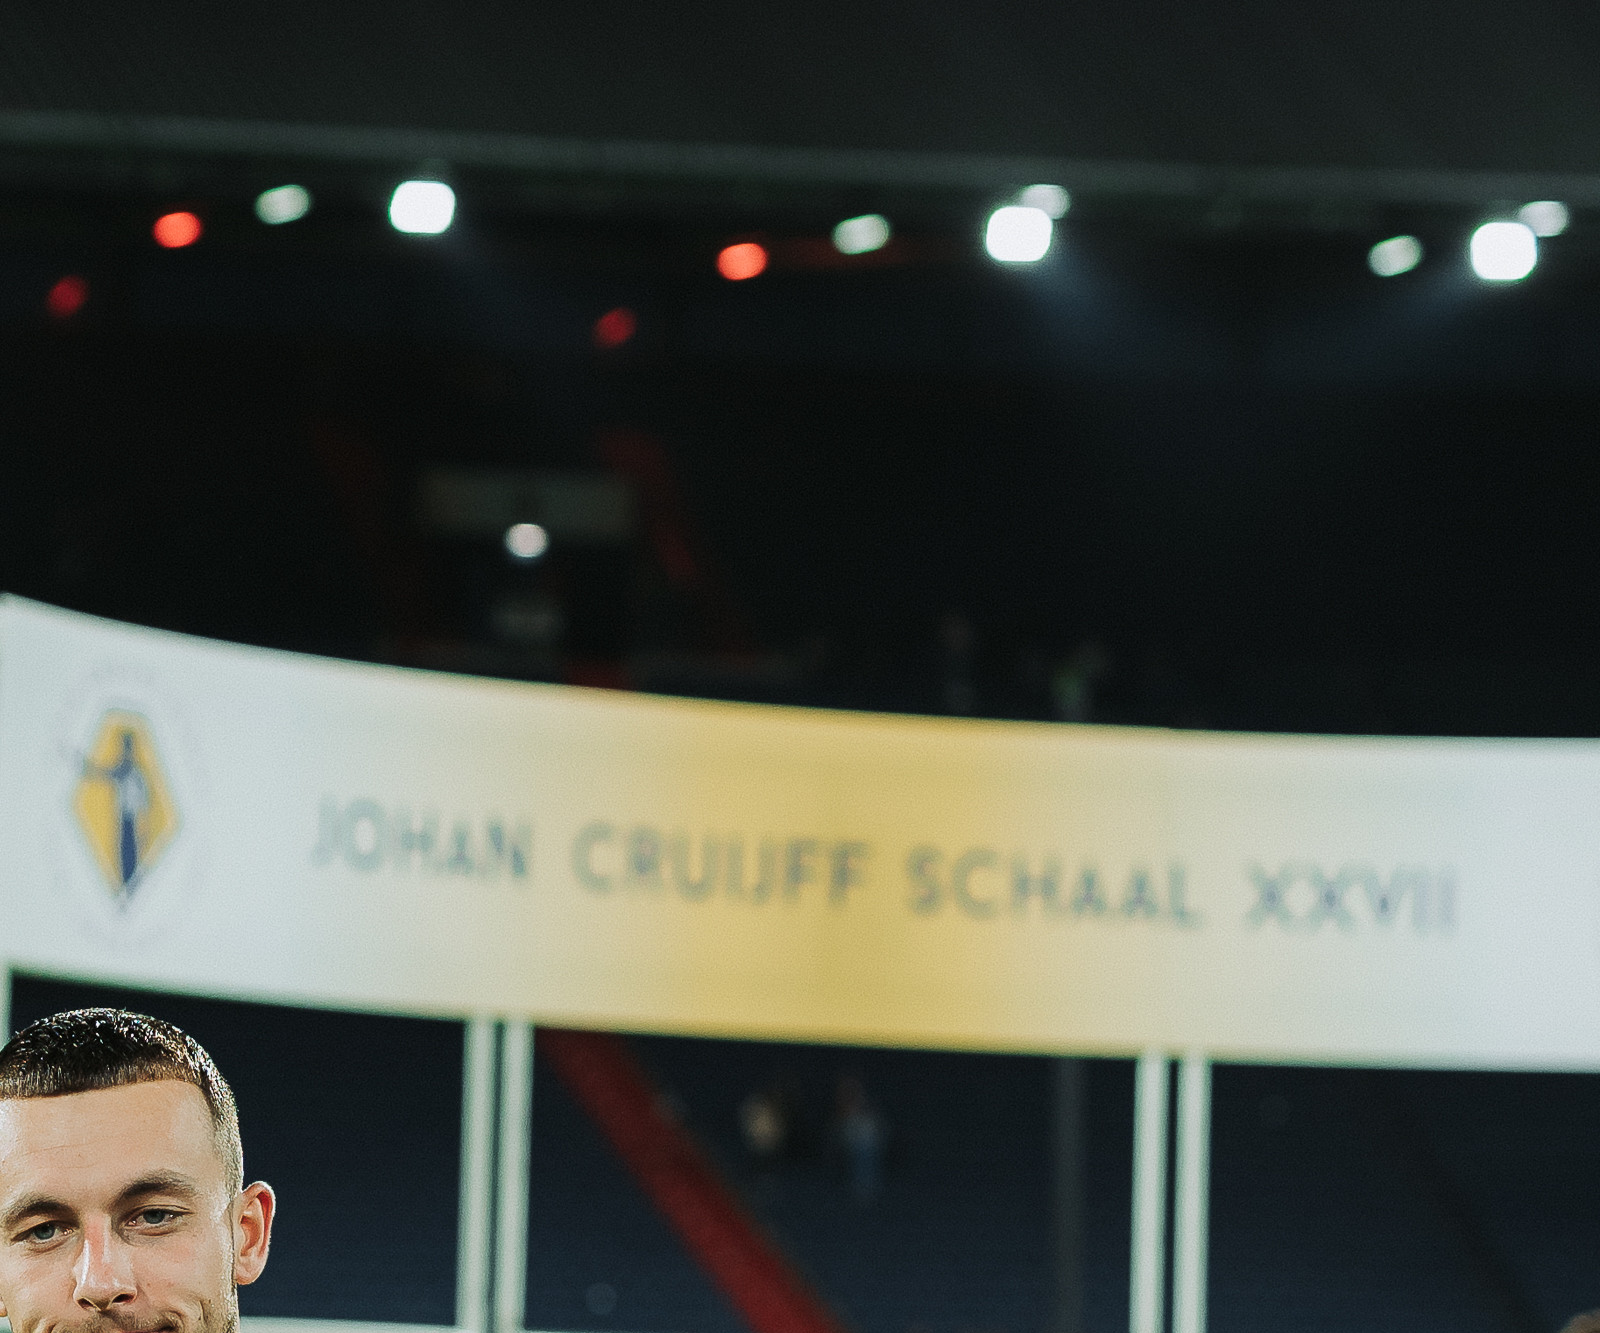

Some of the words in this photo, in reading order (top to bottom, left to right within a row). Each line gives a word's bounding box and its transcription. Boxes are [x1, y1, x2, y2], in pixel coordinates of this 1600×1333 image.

[315, 798, 528, 879] JOHAN
[571, 823, 870, 911] CRUIJFF
[907, 845, 1201, 930] SCHAAL
[1247, 860, 1458, 934] XXVII
